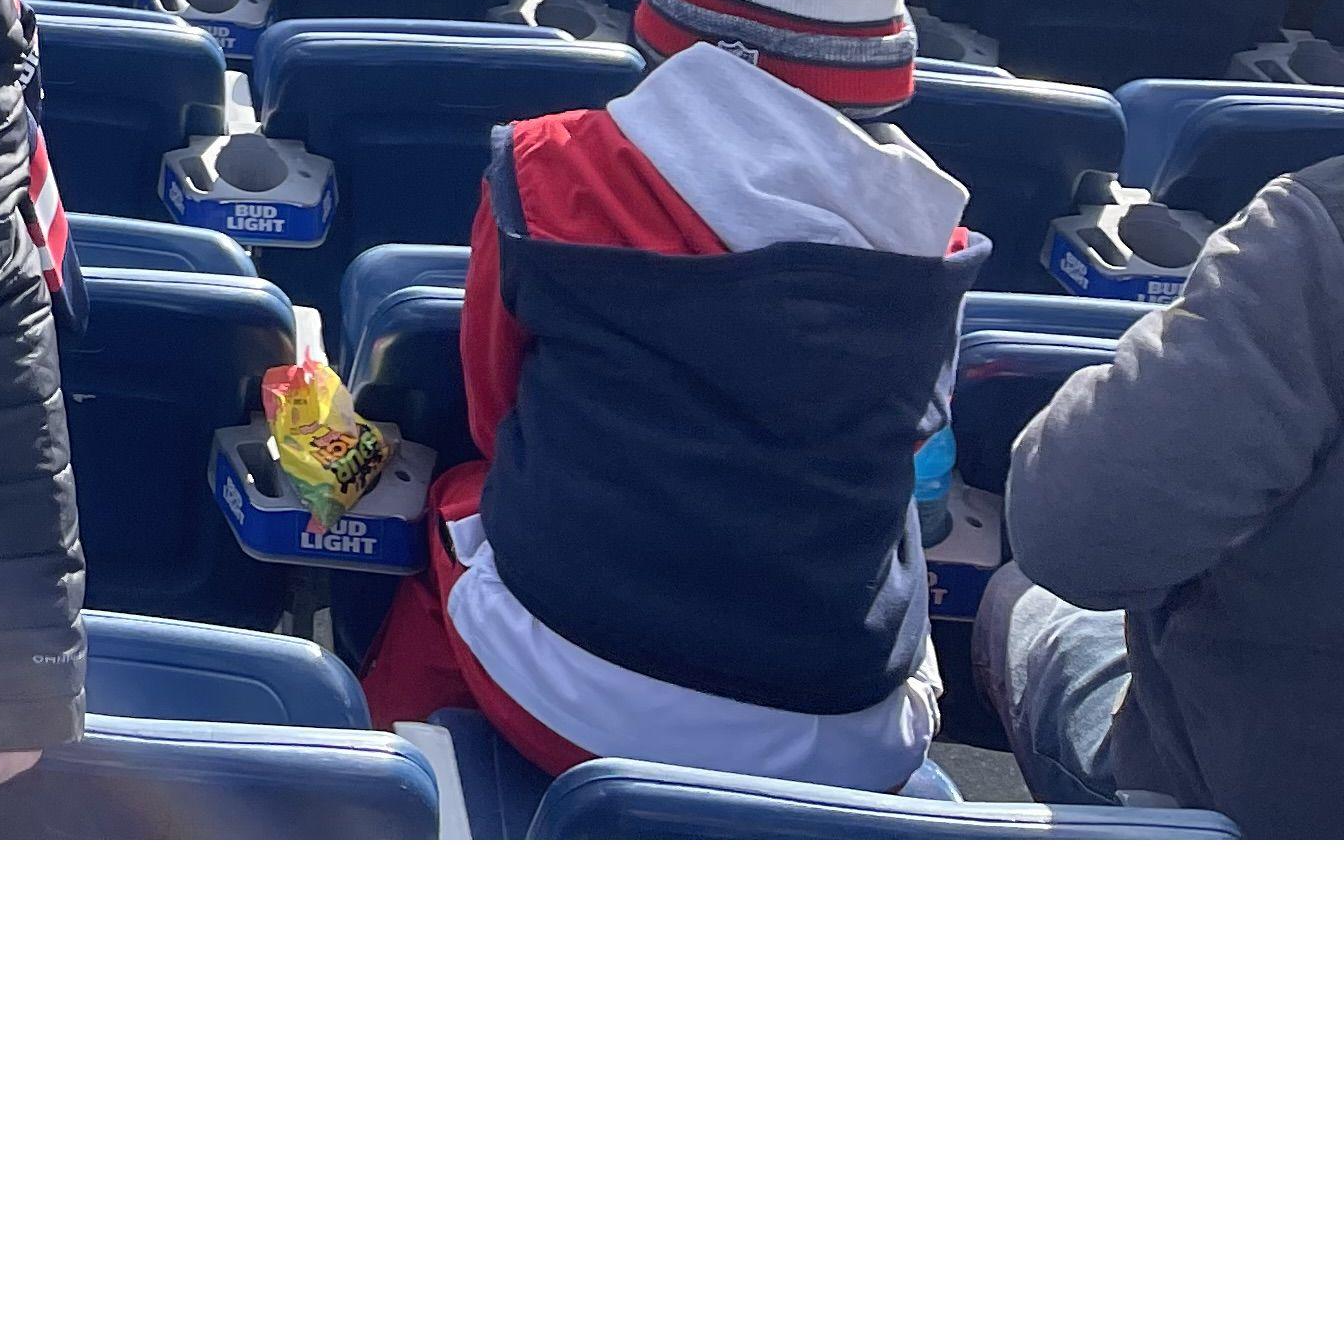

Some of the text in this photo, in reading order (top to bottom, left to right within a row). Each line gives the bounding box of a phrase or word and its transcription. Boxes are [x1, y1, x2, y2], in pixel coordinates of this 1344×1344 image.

[234, 203, 278, 219] BUD
[226, 216, 286, 234] LIGHT
[300, 531, 378, 555] LIGHT
